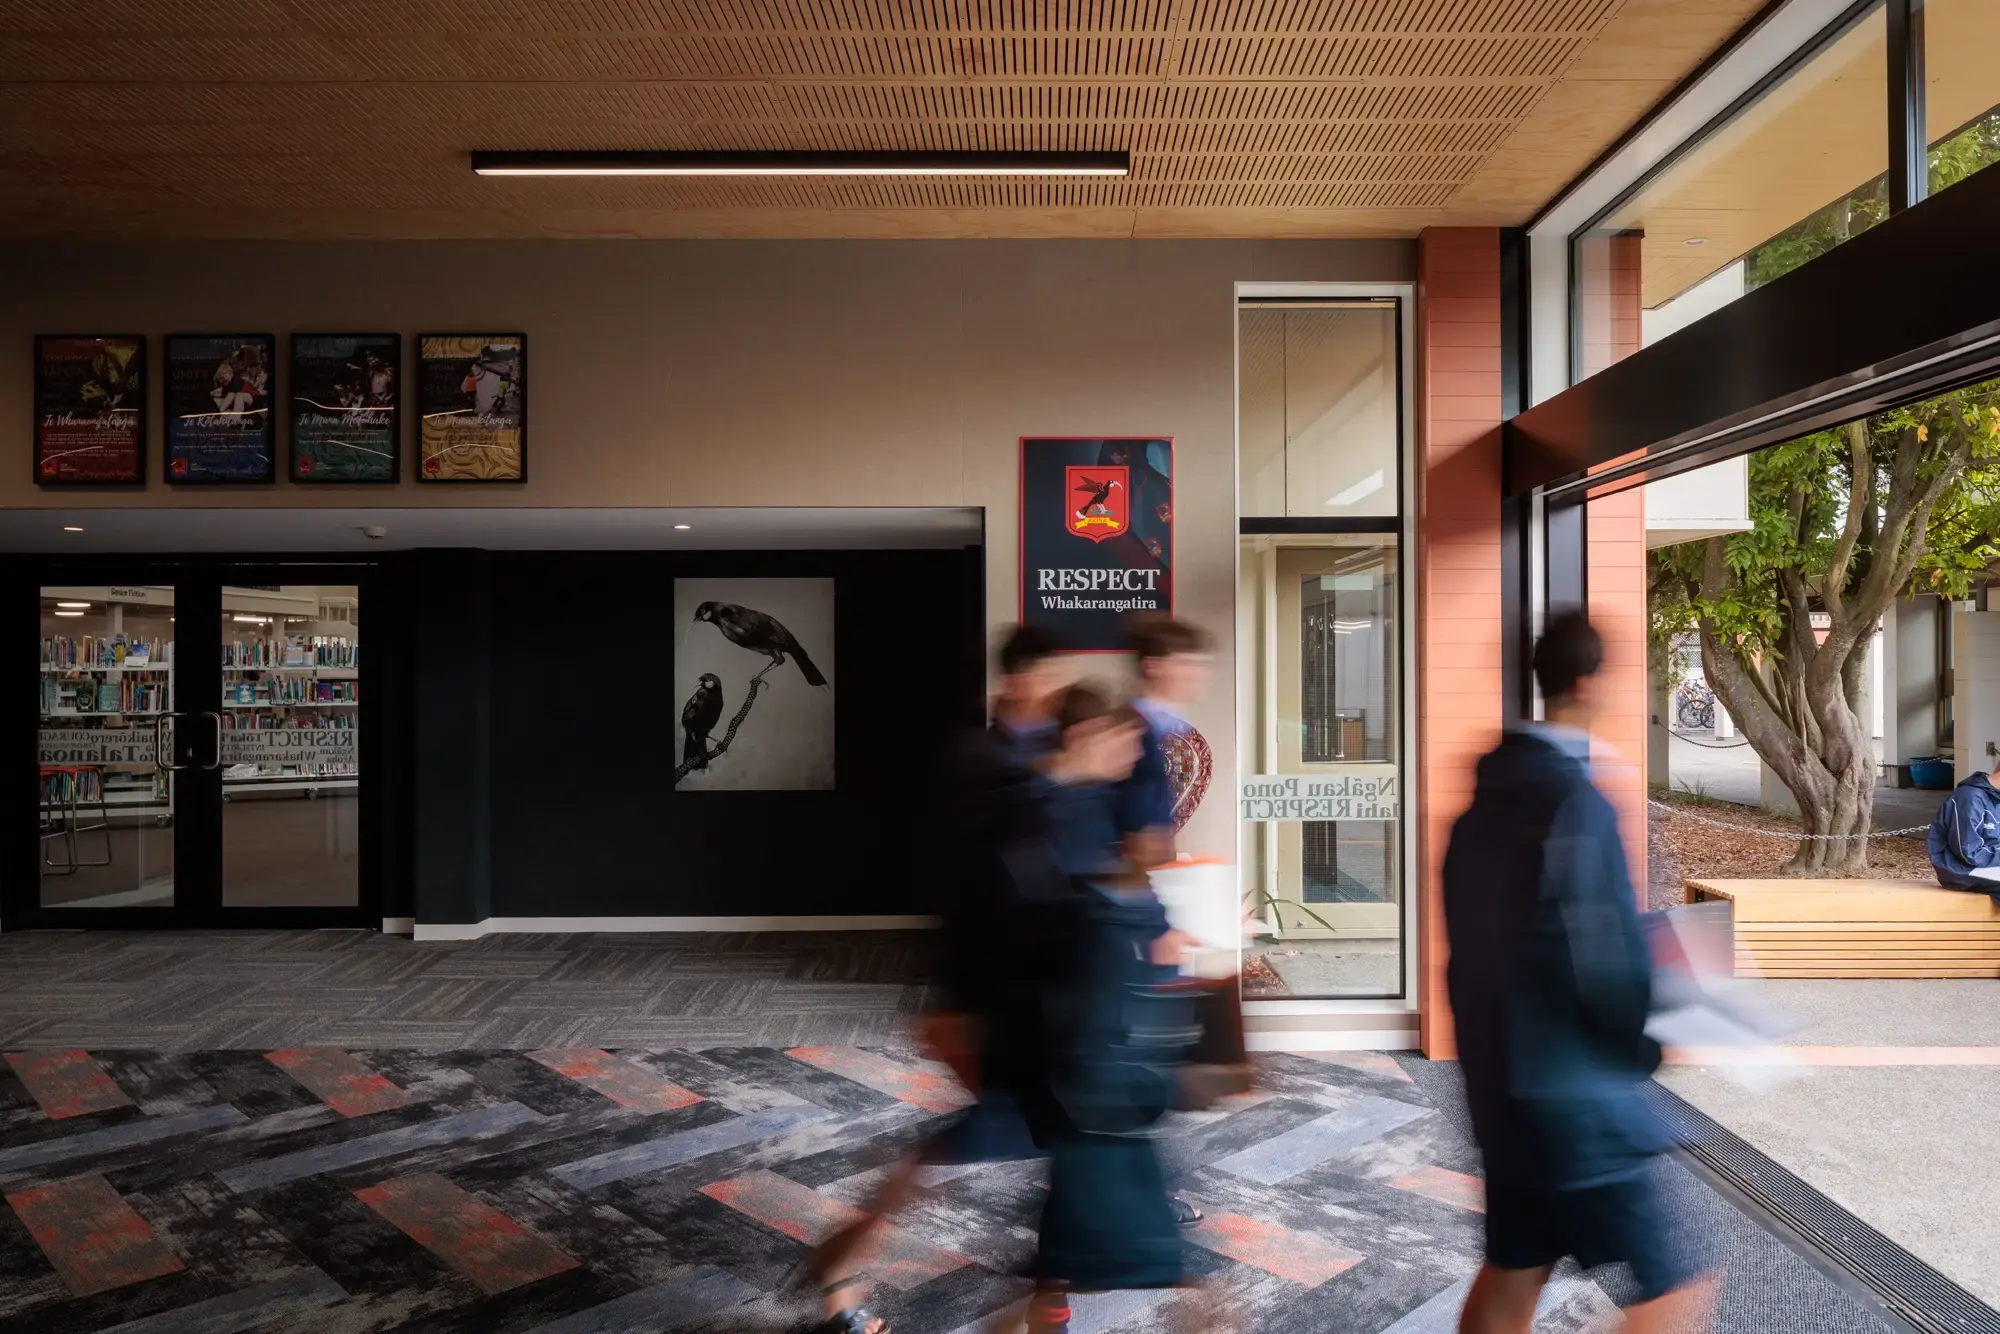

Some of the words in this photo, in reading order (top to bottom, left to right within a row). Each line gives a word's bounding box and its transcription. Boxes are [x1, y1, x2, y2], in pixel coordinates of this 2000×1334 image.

[44, 413, 56, 427] Te
[184, 416, 195, 427] Te
[299, 413, 309, 427] Te
[1037, 568, 1160, 591] RESPECT
[1040, 595, 1157, 613] Whakarangatira
